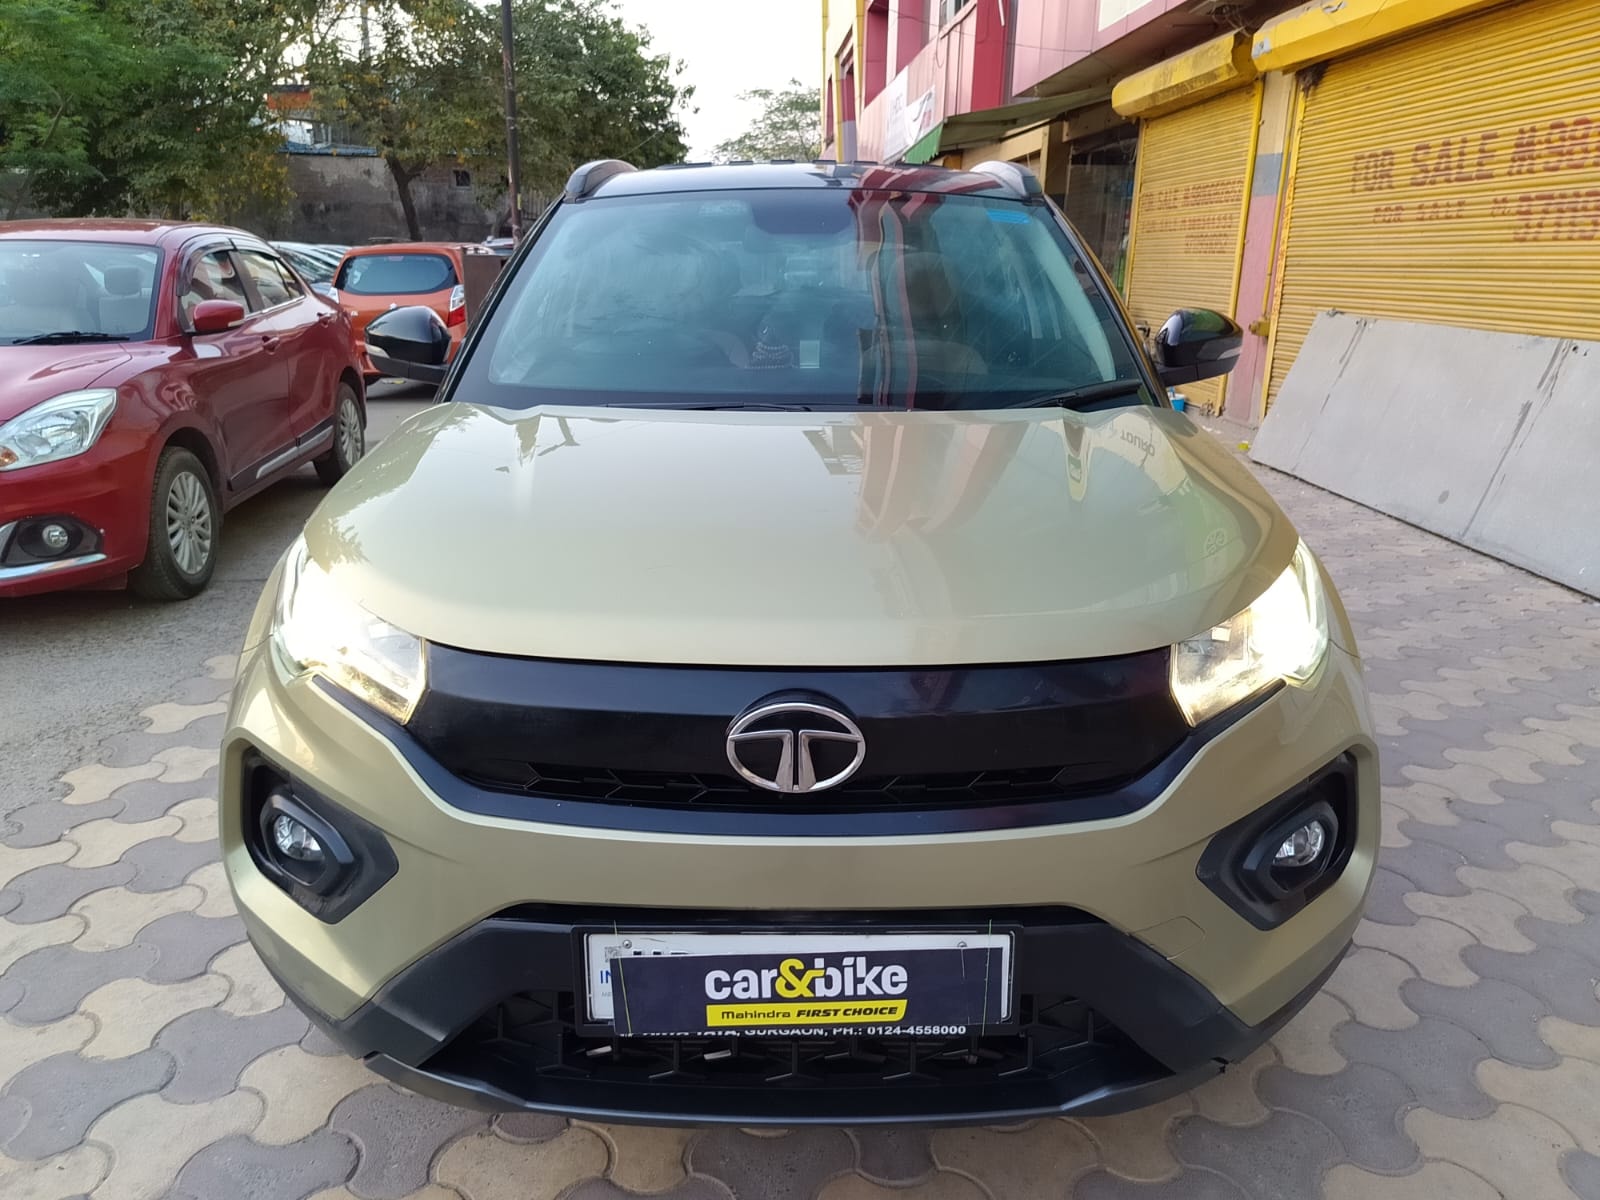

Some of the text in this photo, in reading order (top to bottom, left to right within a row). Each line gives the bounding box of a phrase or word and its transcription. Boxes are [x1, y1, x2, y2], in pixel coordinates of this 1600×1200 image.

[1351, 150, 1395, 193] FOR
[1410, 132, 1499, 186] SALE
[1416, 199, 1466, 221] SALE
[721, 1006, 898, 1019] Mahindra FIRST CHOICE
[867, 1025, 967, 1036] 0124-4558000
